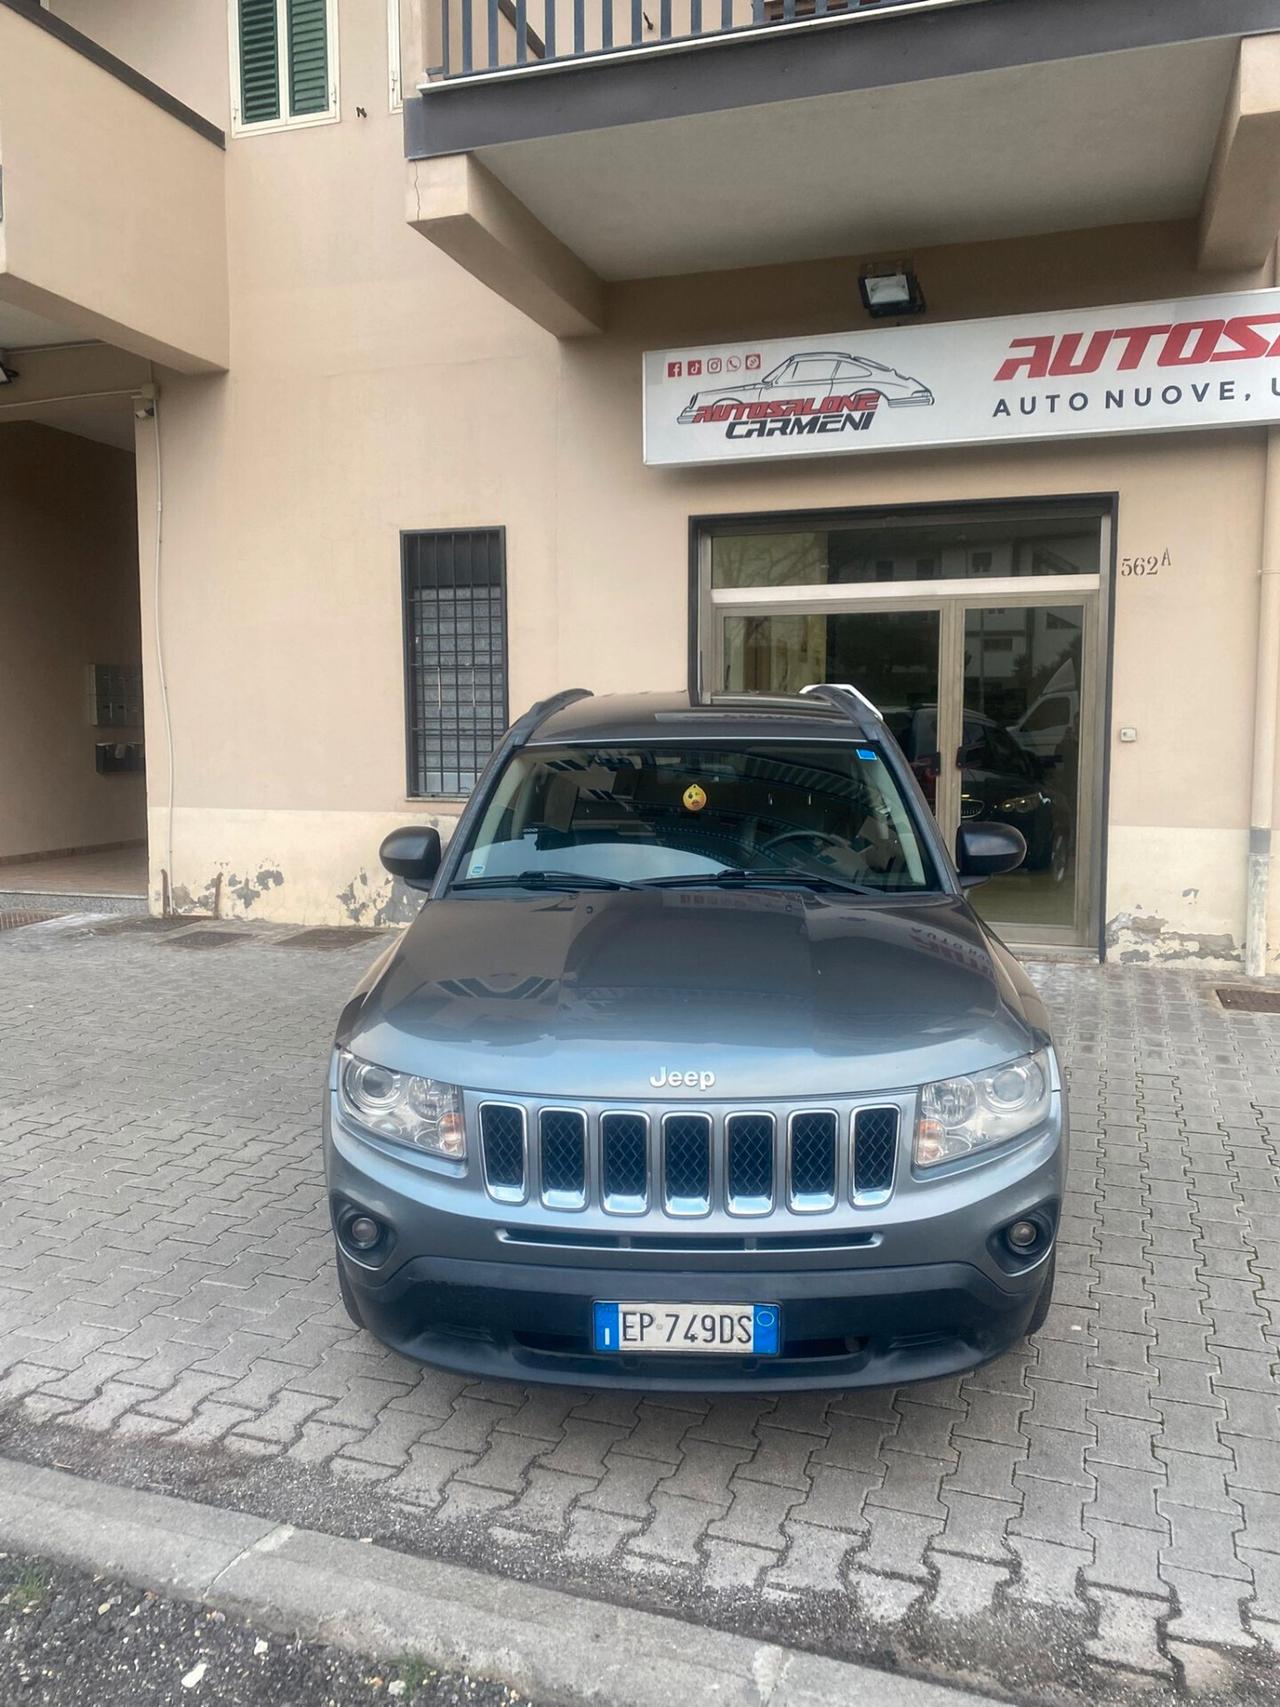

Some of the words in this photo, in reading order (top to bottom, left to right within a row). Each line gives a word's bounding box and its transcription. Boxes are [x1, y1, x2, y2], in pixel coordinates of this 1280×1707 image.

[993, 312, 1280, 382] AUTOS
[693, 392, 881, 423] AUTOSALONE
[992, 391, 1089, 418] AUTO
[1105, 379, 1252, 409] NUOVE,
[725, 412, 876, 440] CARMENI
[649, 1065, 716, 1092] Jeep
